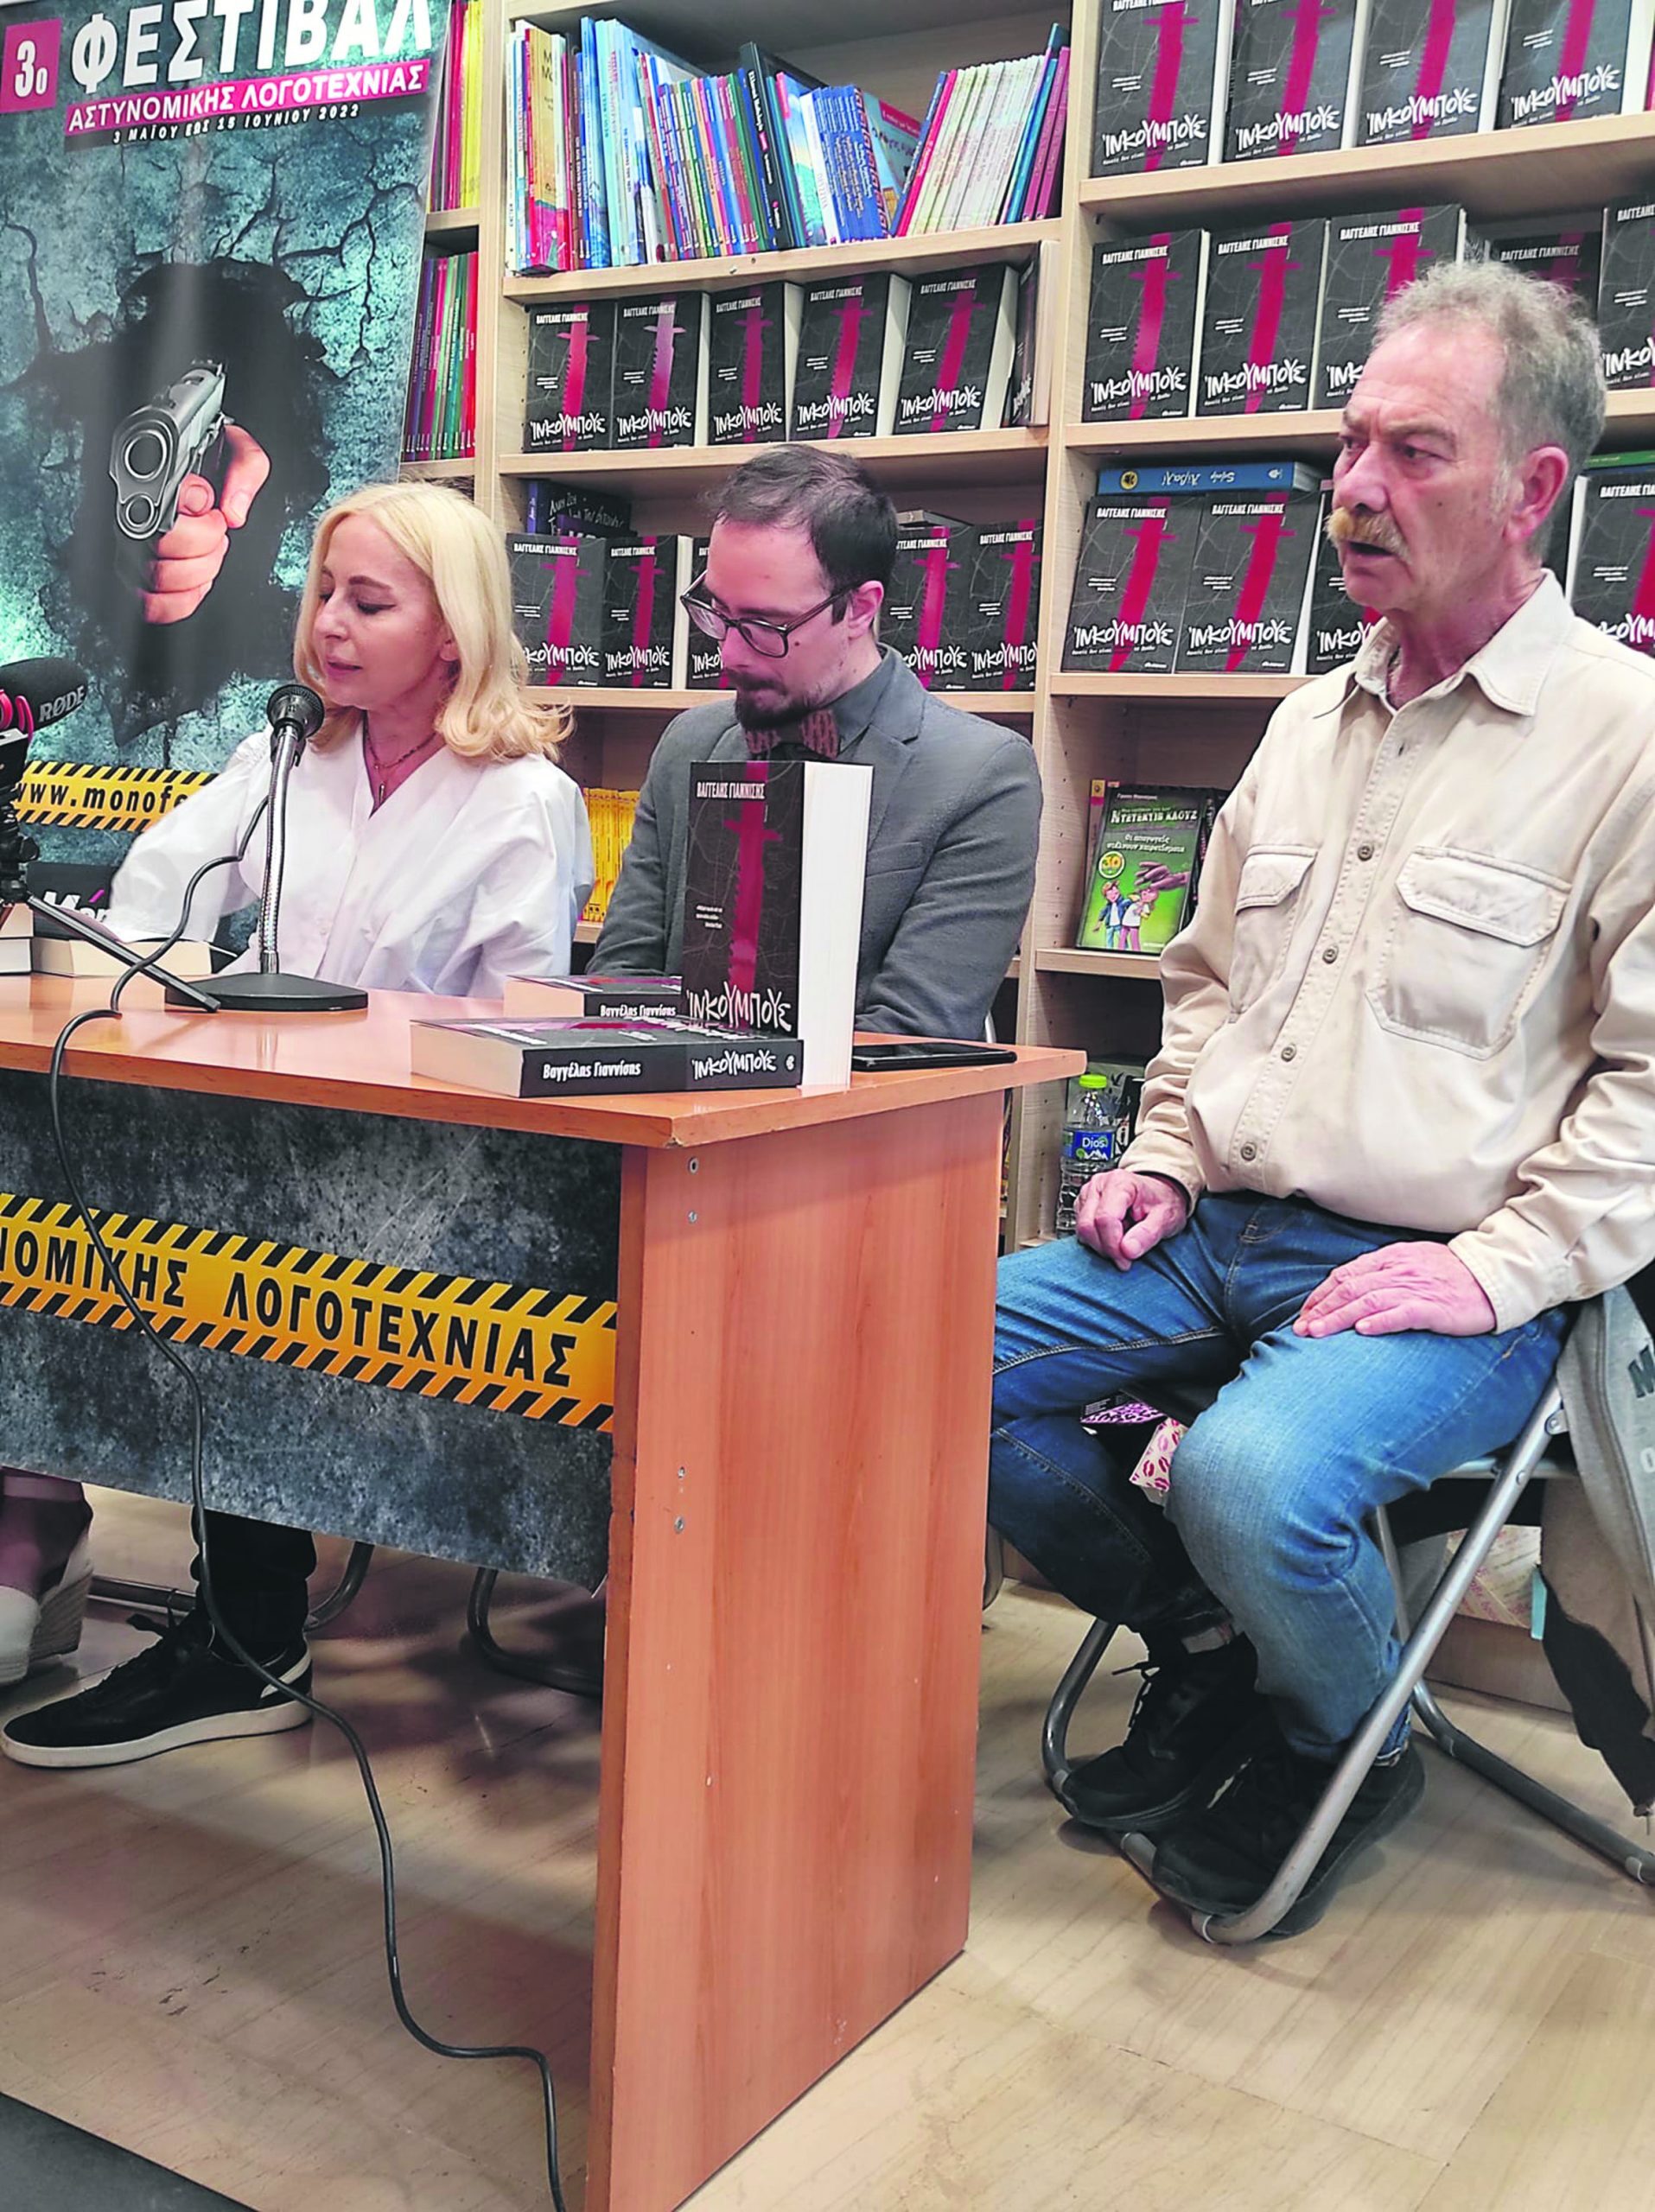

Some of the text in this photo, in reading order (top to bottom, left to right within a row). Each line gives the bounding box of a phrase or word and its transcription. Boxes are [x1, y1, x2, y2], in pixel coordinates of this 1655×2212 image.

[69, 0, 431, 94] ΦΕΣΤΙΒΑΛ
[68, 66, 424, 132] ΑΣΤΥΝΟΜΙΚΗΣ ΛΟΓΟΤΕΧΝΙΑΣ
[113, 132, 122, 144] 3
[244, 110, 311, 130] ΙΟΥΝΙΟΥ
[319, 104, 360, 121] 2022
[543, 1058, 641, 1083] Βαγγέλης Γιαννίσης
[222, 1270, 577, 1388] ΛΟΓΟΤΕΧΝΙΑΣ
